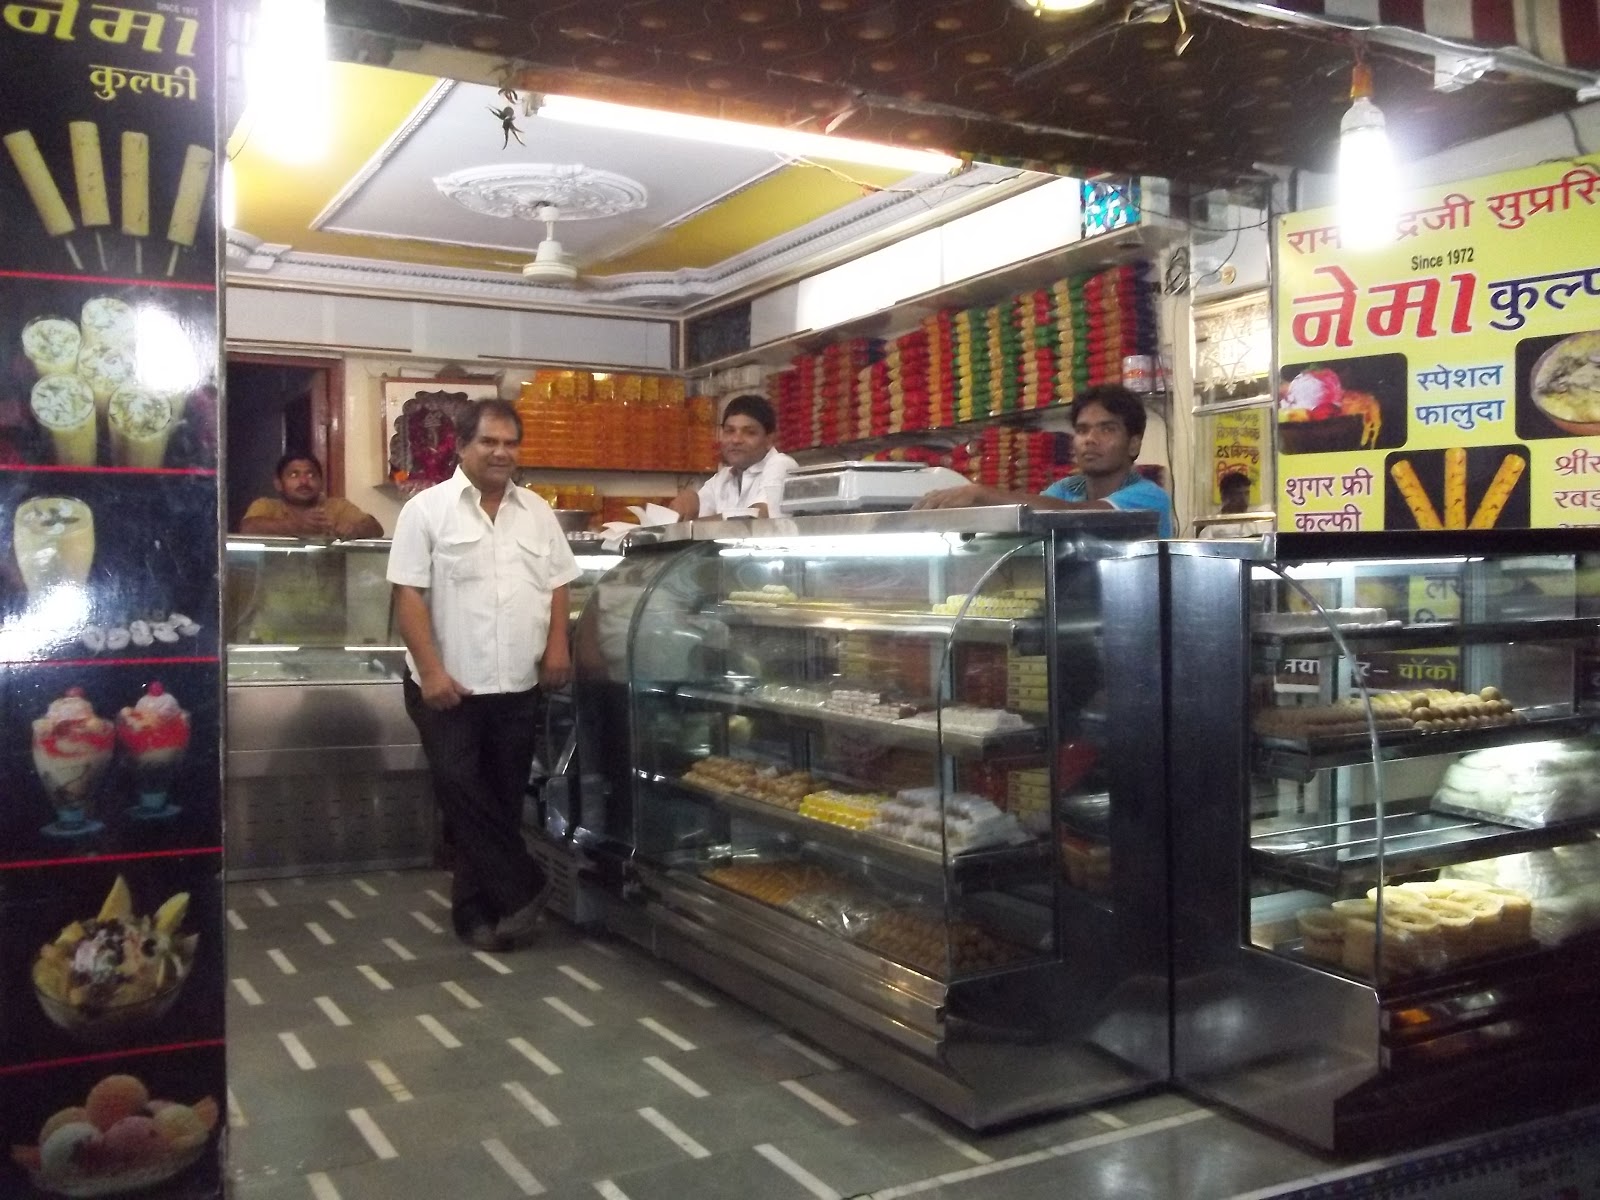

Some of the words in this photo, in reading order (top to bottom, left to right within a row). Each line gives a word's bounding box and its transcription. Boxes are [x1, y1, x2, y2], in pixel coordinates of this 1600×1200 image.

[4, 0, 198, 57] नमा
[89, 65, 199, 101] कुल्फी
[1411, 256, 1443, 271] Since
[1446, 247, 1475, 266] 1972
[1292, 265, 1476, 348] नेमा
[1417, 364, 1504, 392] स्पेशल
[1415, 399, 1506, 430] फालुदा
[1286, 476, 1335, 505] शुगर
[1341, 467, 1374, 496] फ्री
[1294, 503, 1363, 531] कल्फी
